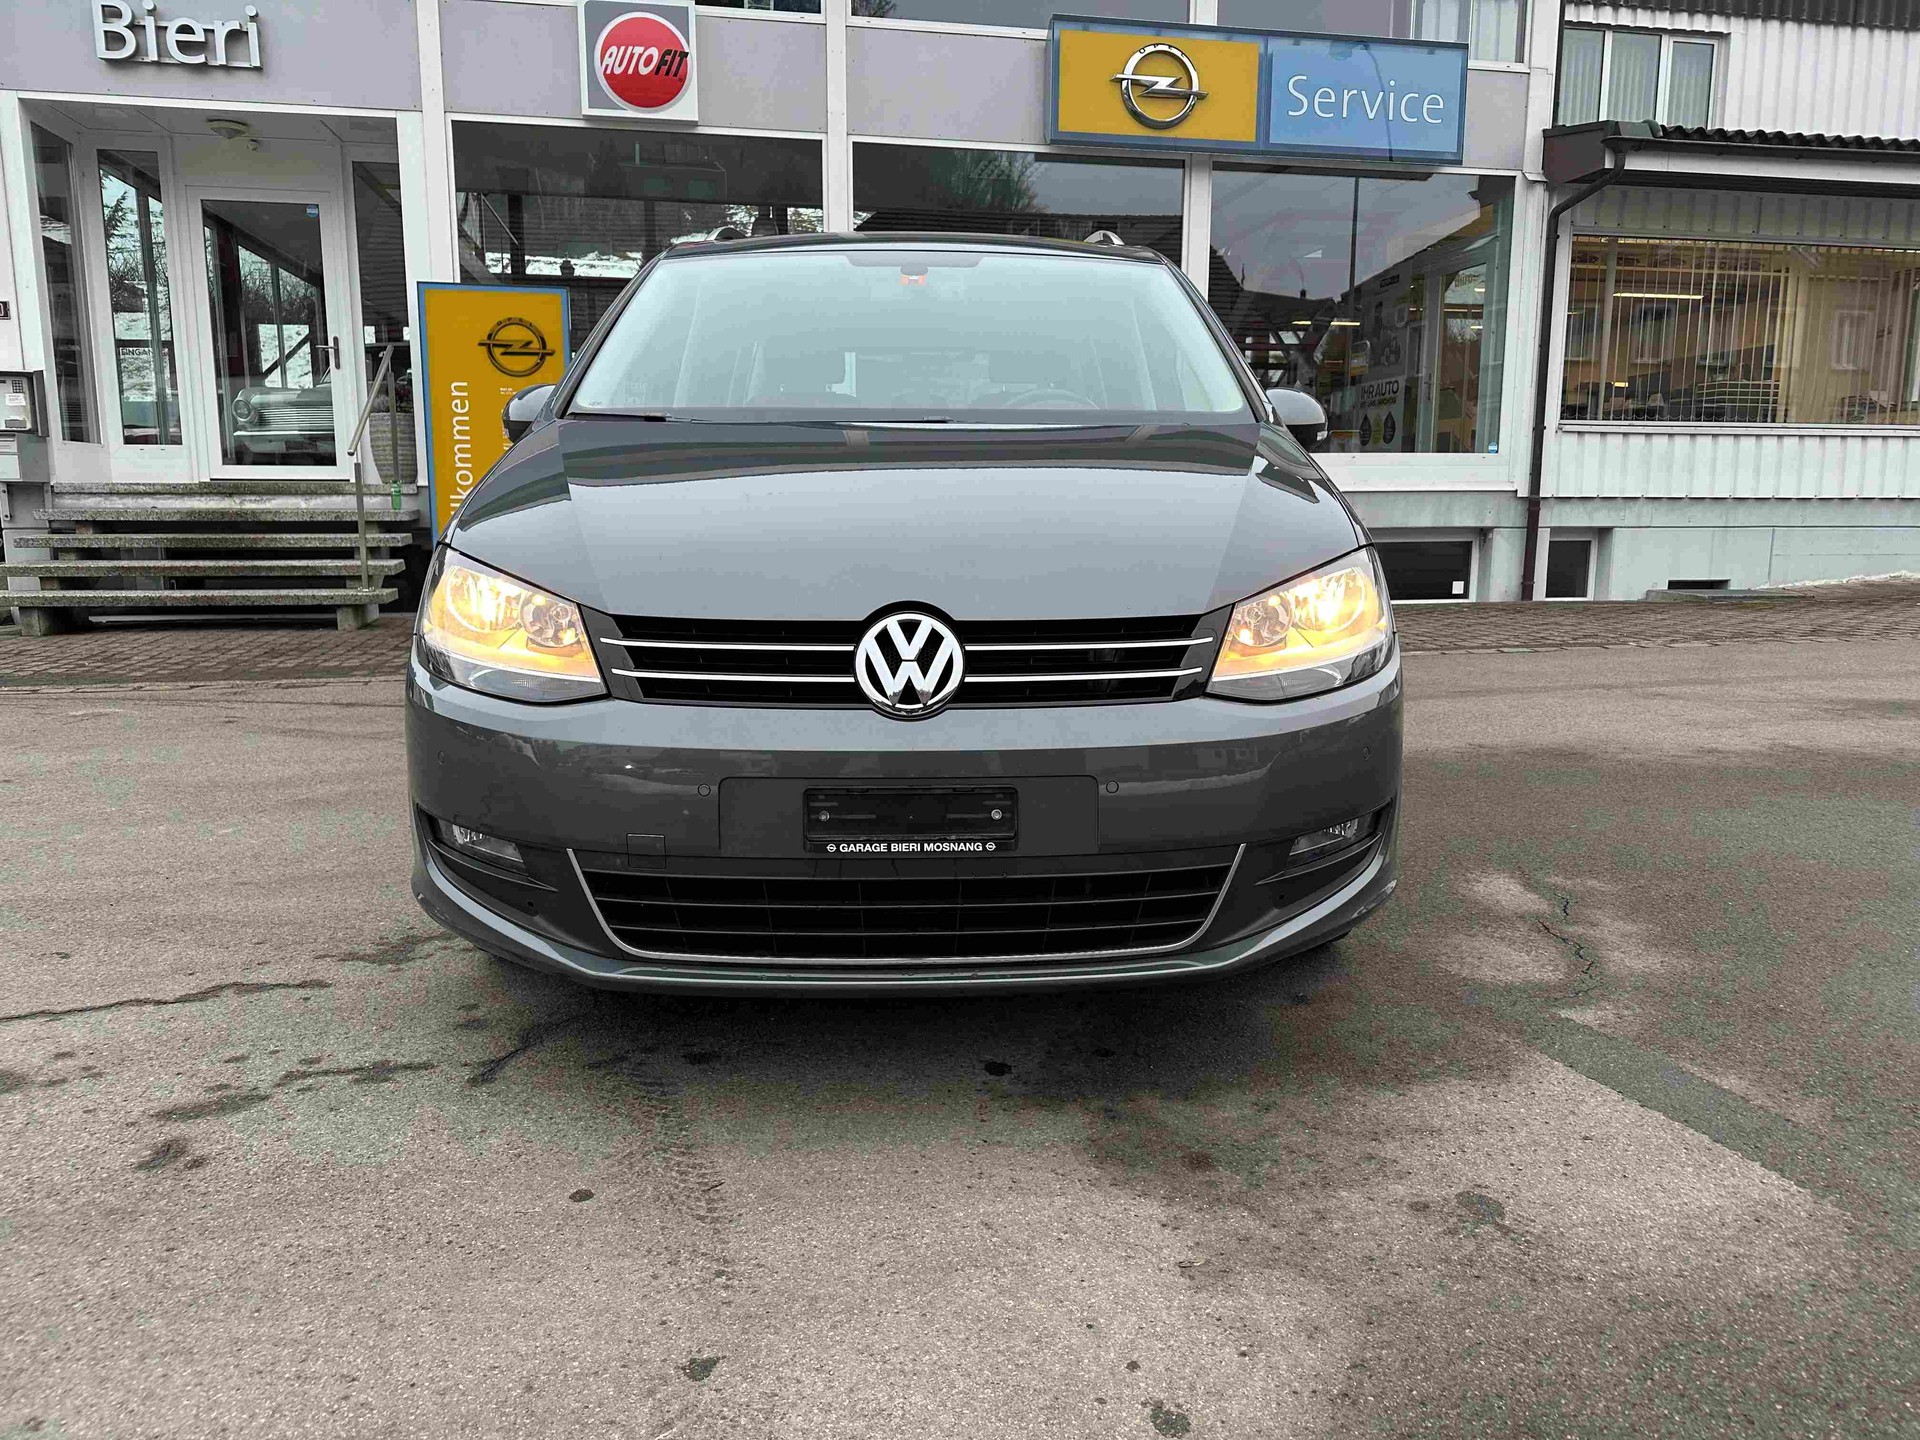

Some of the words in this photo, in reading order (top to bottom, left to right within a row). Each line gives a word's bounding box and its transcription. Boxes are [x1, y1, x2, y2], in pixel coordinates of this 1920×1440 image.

[91, 0, 262, 67] Bieri
[601, 45, 689, 77] AUTOFIT
[1287, 74, 1444, 124] Service
[120, 348, 154, 356] EINGAN
[1375, 380, 1399, 397] AUTO
[450, 381, 474, 515] kommen
[839, 843, 888, 853] GARAGE
[890, 843, 921, 852] BIERI
[923, 842, 983, 852] MOSNANG
